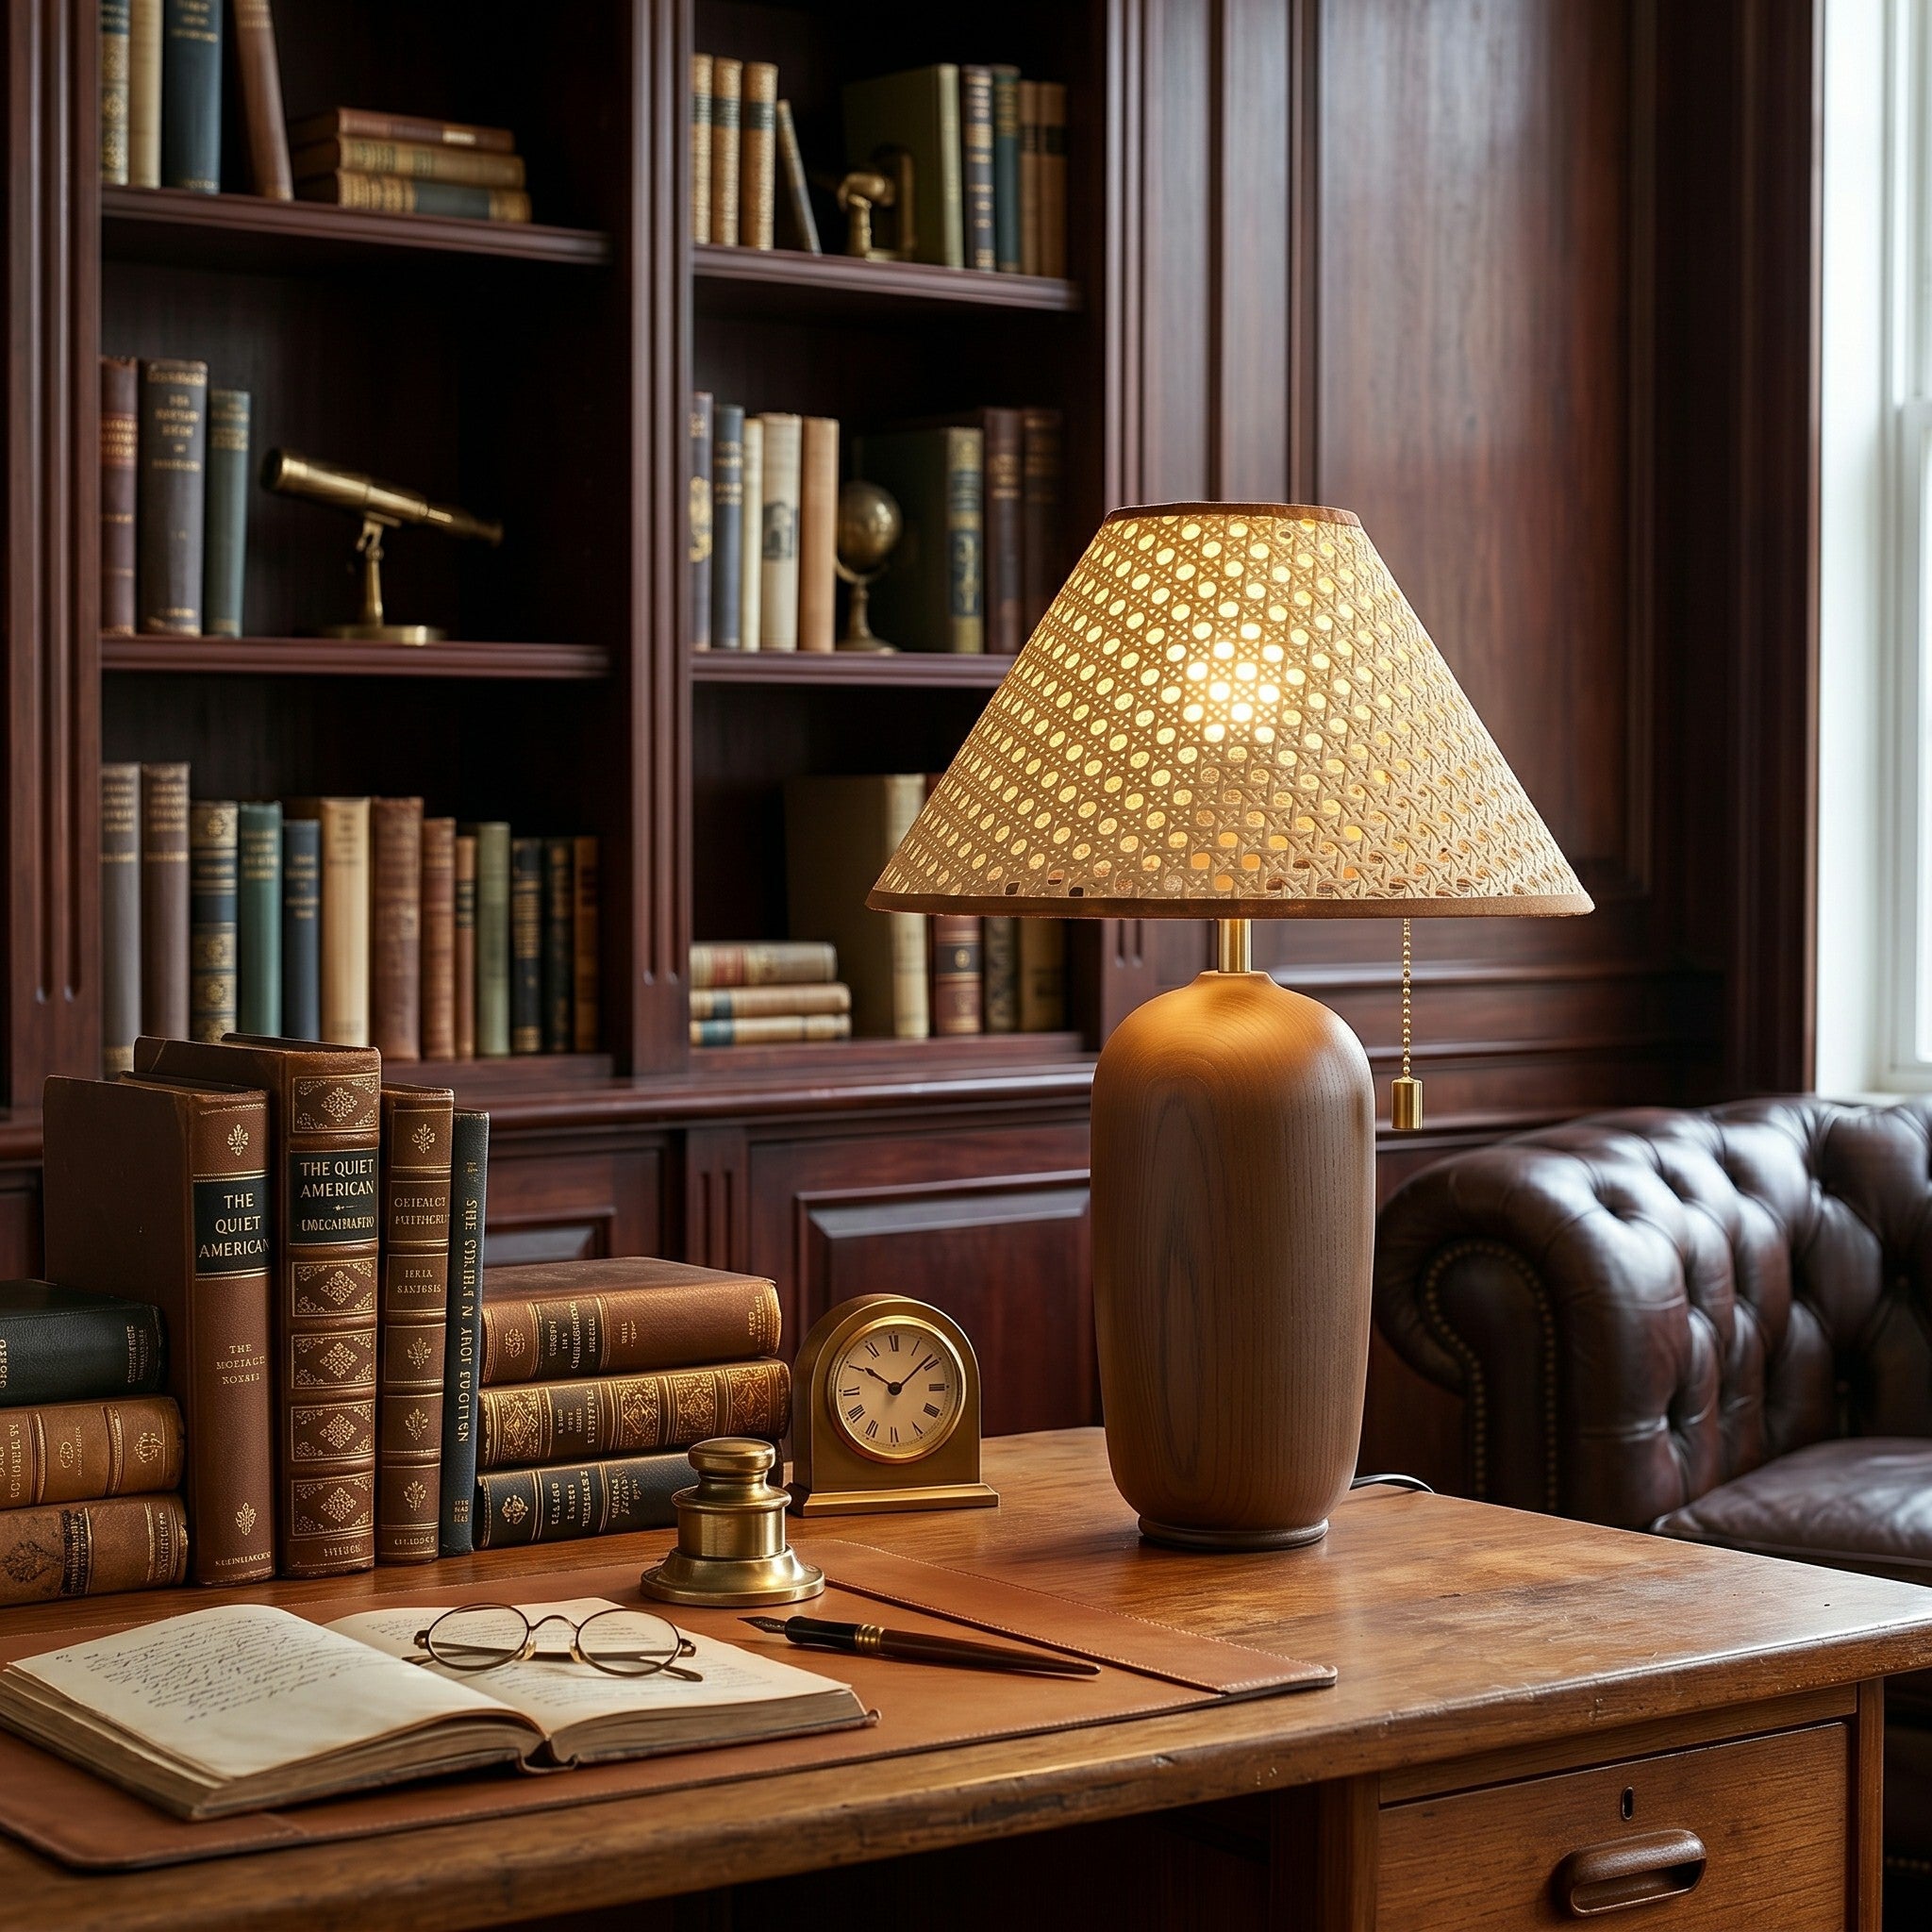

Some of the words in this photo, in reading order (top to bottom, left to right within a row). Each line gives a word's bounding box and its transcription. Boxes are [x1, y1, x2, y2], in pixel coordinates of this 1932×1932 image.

[300, 1161, 330, 1176] THE
[334, 1158, 374, 1177] QUIET
[300, 1180, 374, 1198] AMERICAN
[224, 1192, 254, 1209] THE
[215, 1215, 260, 1235] QUIET
[198, 1238, 270, 1258] AMERICAN
[229, 1343, 252, 1354] THE
